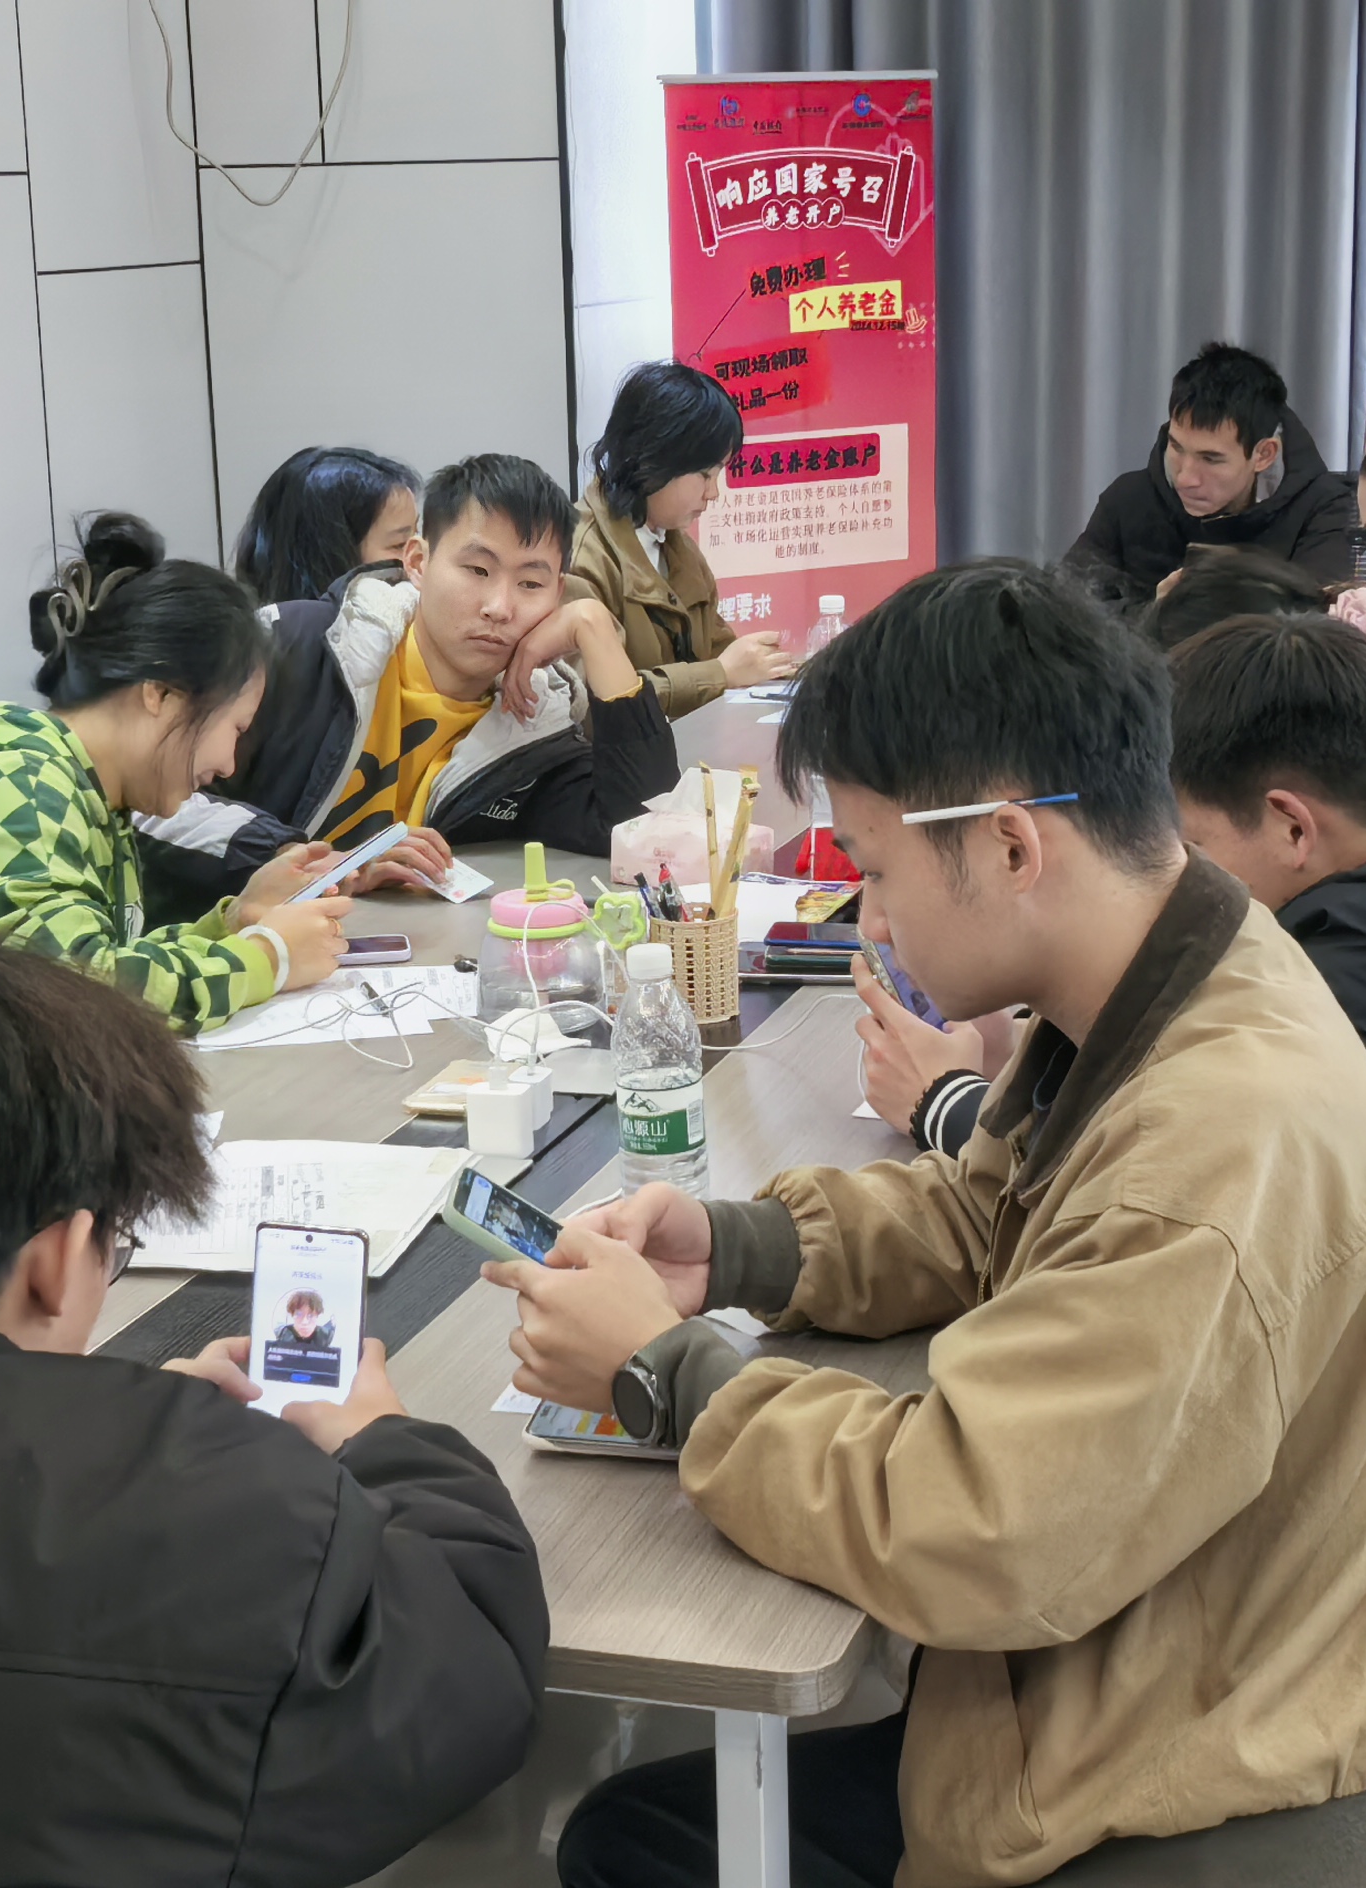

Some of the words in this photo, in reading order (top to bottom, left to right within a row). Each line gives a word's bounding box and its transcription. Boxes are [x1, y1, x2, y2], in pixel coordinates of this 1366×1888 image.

[716, 163, 884, 211] 响应国家号召
[764, 203, 841, 227] 养老开户
[750, 257, 827, 297] 免费办理
[795, 289, 896, 324] 个人养老金
[714, 347, 808, 381] 可现场领取
[728, 443, 876, 479] 什么是养老金账户
